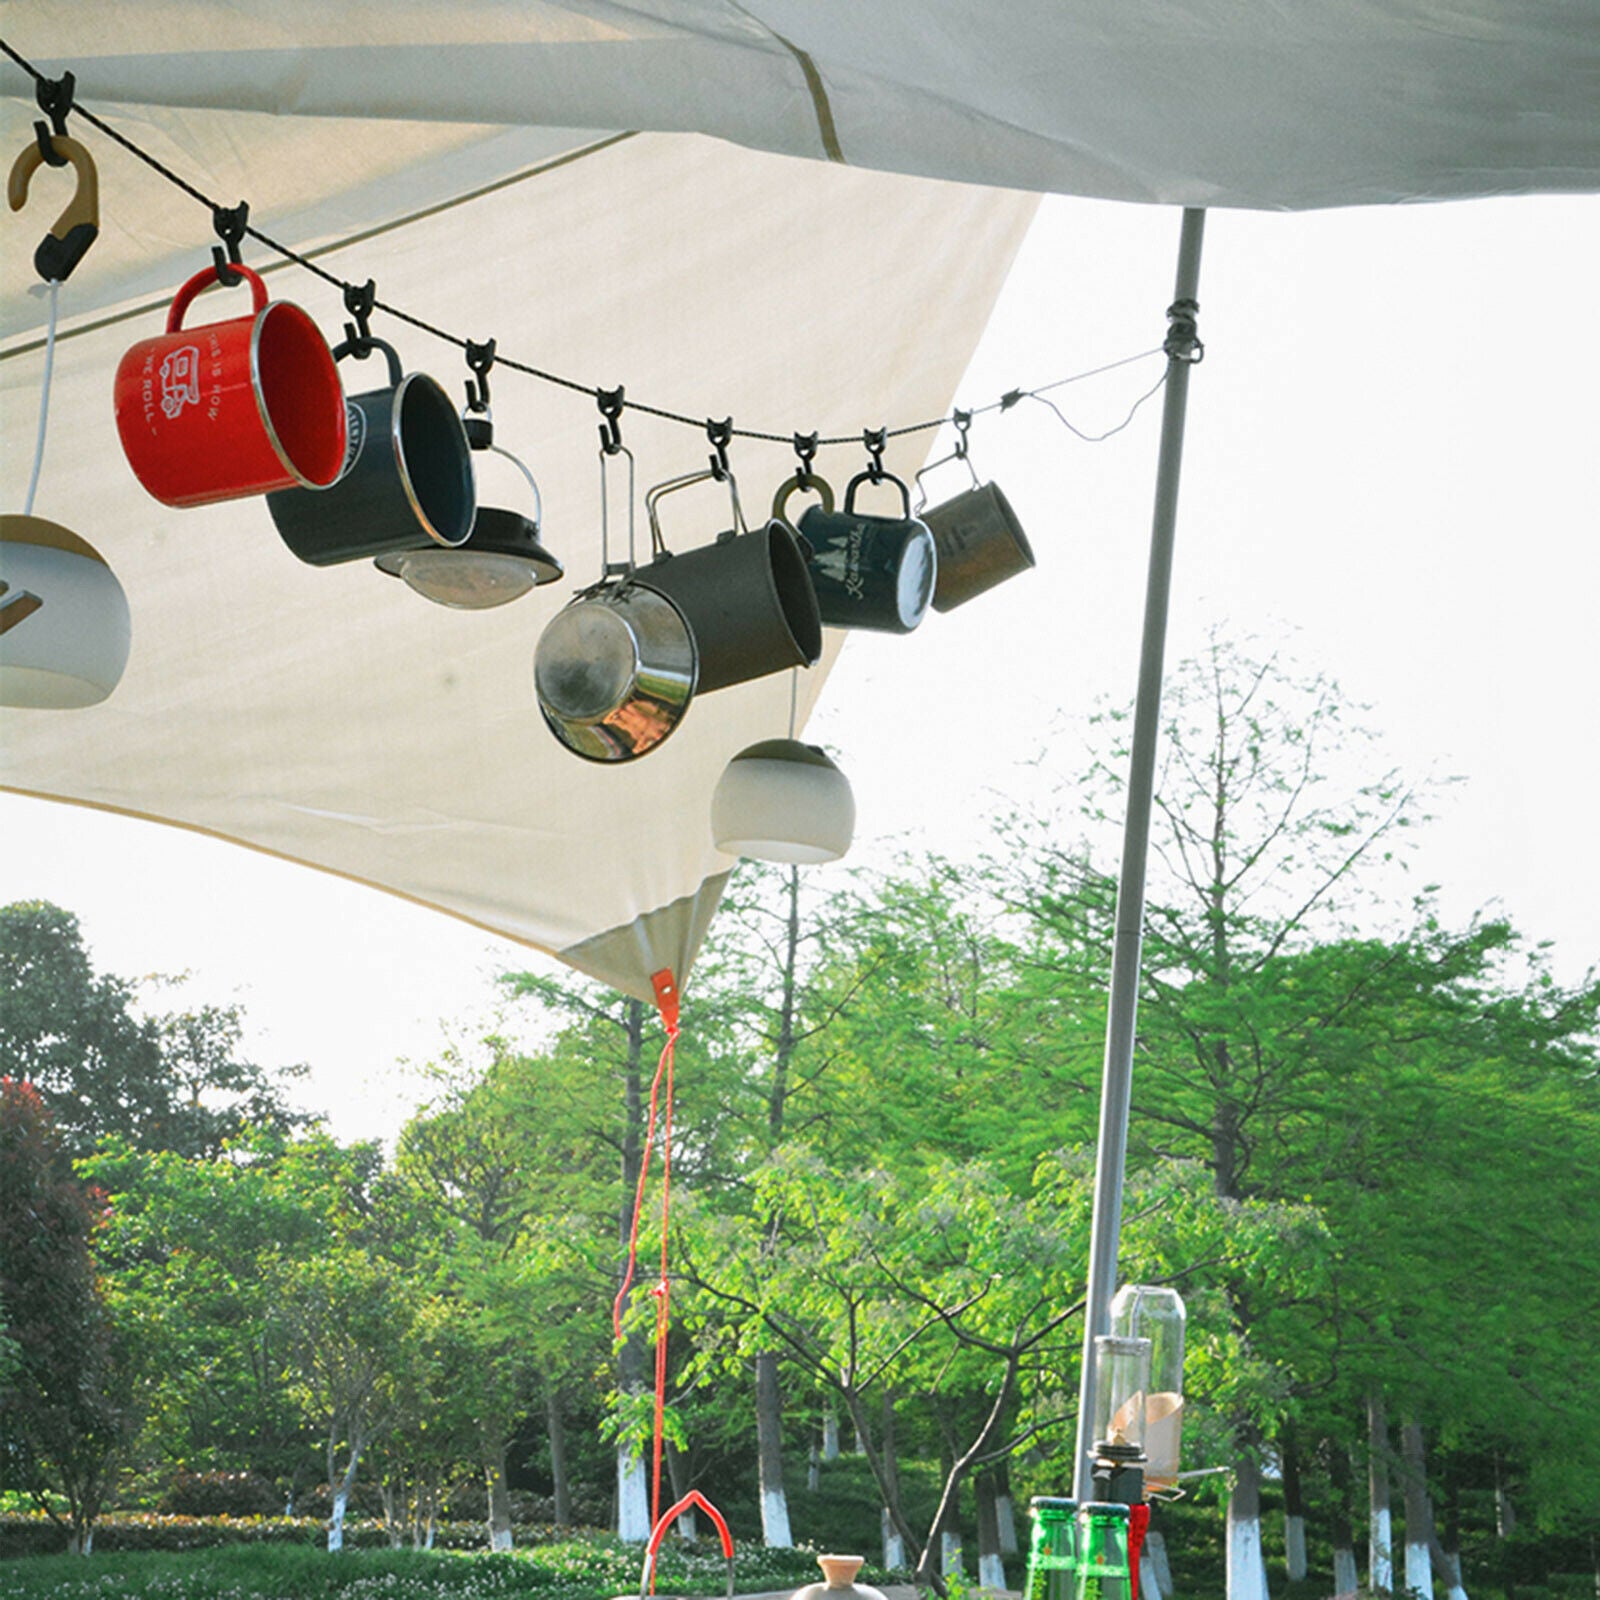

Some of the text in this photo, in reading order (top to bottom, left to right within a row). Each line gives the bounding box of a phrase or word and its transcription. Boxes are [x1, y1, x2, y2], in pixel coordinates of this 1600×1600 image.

[211, 361, 221, 378] IS
[142, 354, 155, 423] WE ROLL
[207, 384, 221, 421] HOW
